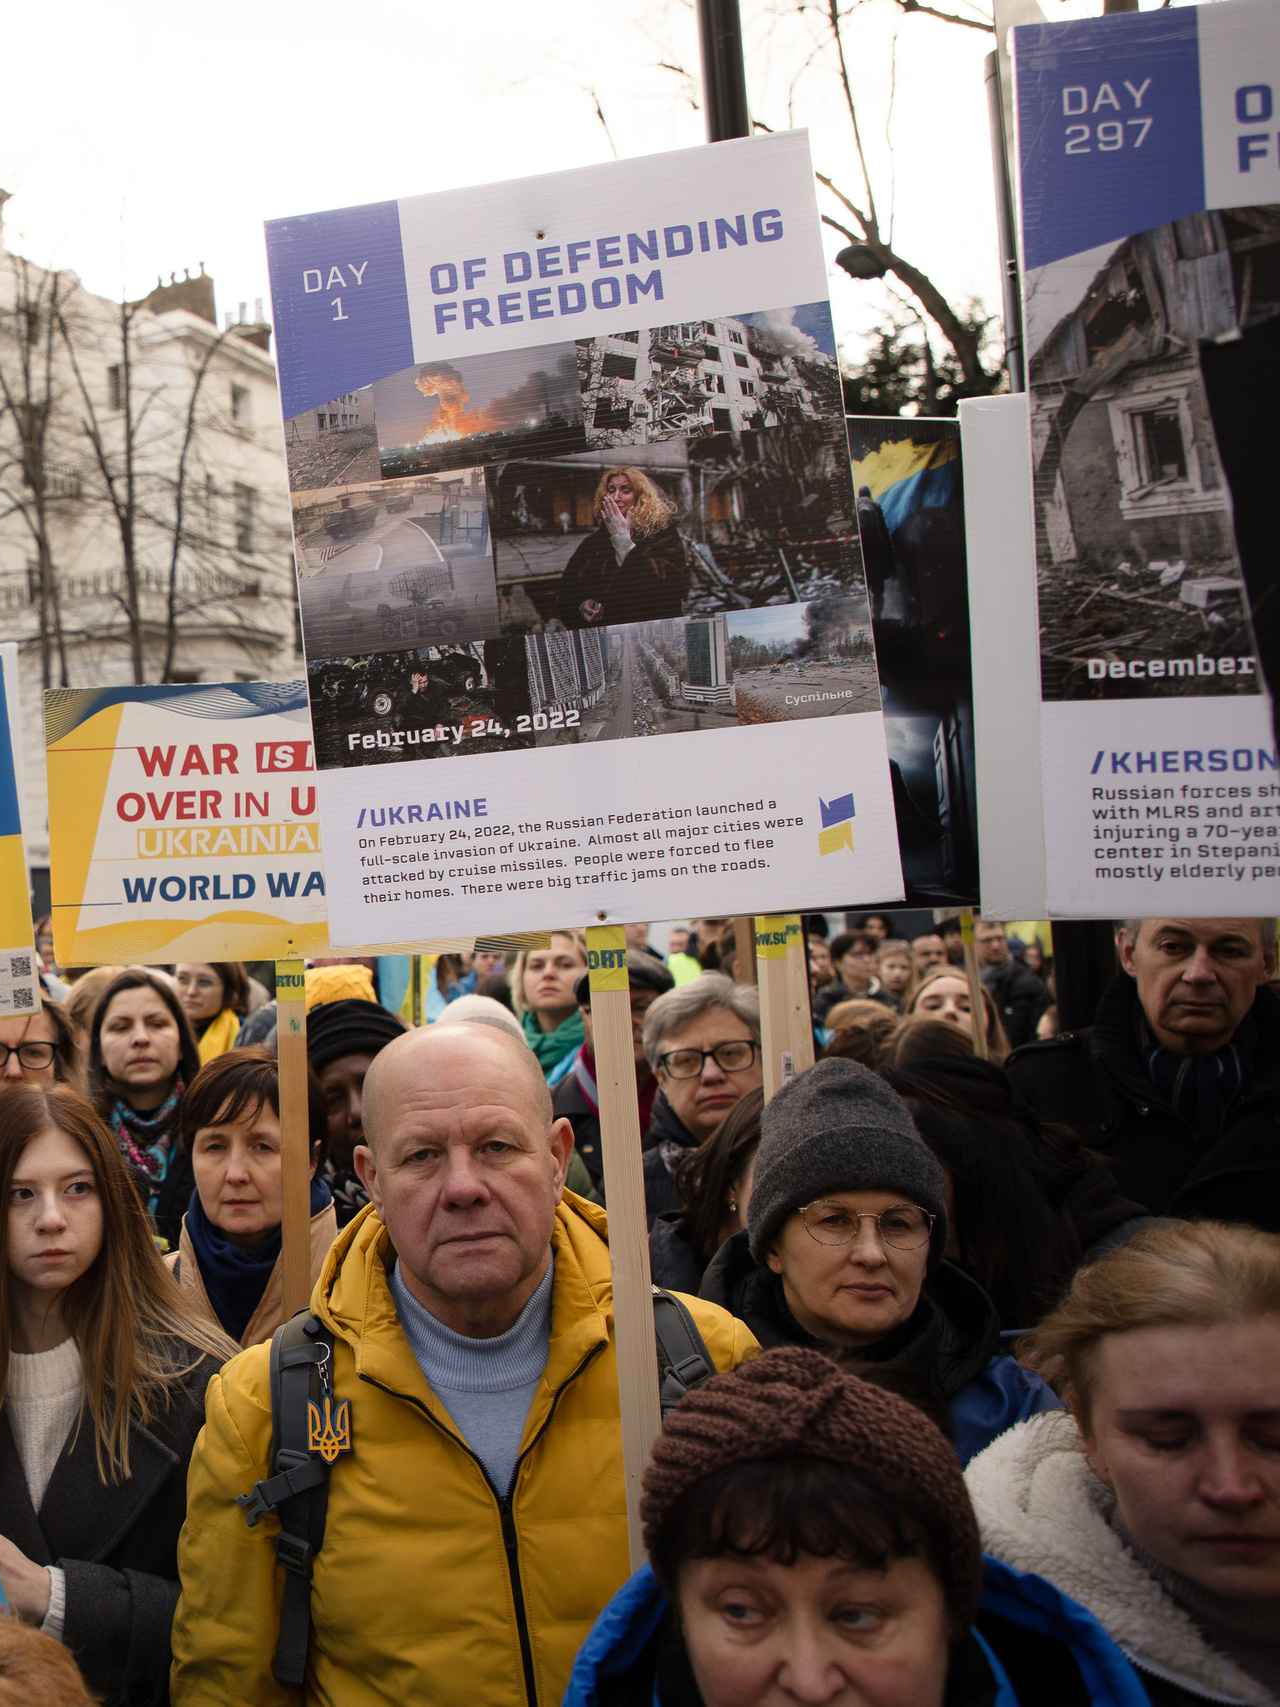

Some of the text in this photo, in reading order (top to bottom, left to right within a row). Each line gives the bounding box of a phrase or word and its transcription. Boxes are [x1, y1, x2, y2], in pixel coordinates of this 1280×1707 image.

[1062, 77, 1152, 116] DAY
[1064, 118, 1154, 155] 297
[429, 208, 784, 295] OF DEFENDING
[302, 260, 369, 294] DAY
[331, 297, 349, 322] 1
[433, 269, 664, 335] FREEDOM
[1087, 654, 1257, 679] December
[785, 689, 853, 706] Суспільне
[347, 709, 581, 750] February 24, 2022
[137, 743, 239, 777] WAR
[261, 745, 295, 770] IS
[1090, 748, 1280, 775] /KHERSON
[116, 790, 222, 822] OVER
[233, 791, 270, 818] IN
[1092, 785, 1174, 801] Russian
[1180, 784, 1252, 800] forces
[356, 798, 488, 828] /UKRAINE
[358, 799, 777, 849] On February 24, 2022, the Russian Federation launched a
[1093, 805, 1140, 820] with
[1146, 805, 1200, 819] MLRS
[1206, 804, 1243, 818] and
[138, 824, 322, 857] UKRAINIA
[360, 816, 804, 867] full-scale invasion of Ukraine. Almost all major cities were
[1093, 825, 1280, 843] injuring a 70-yea
[362, 838, 774, 885] attacked by cruise missiles. People were forced to flee
[1094, 846, 1165, 859] center
[1170, 844, 1191, 858] in
[123, 873, 256, 903] WORLD
[363, 858, 770, 904] their homes. There were big traffic jams on the roads.
[1095, 863, 1280, 882] mostly elderly pe
